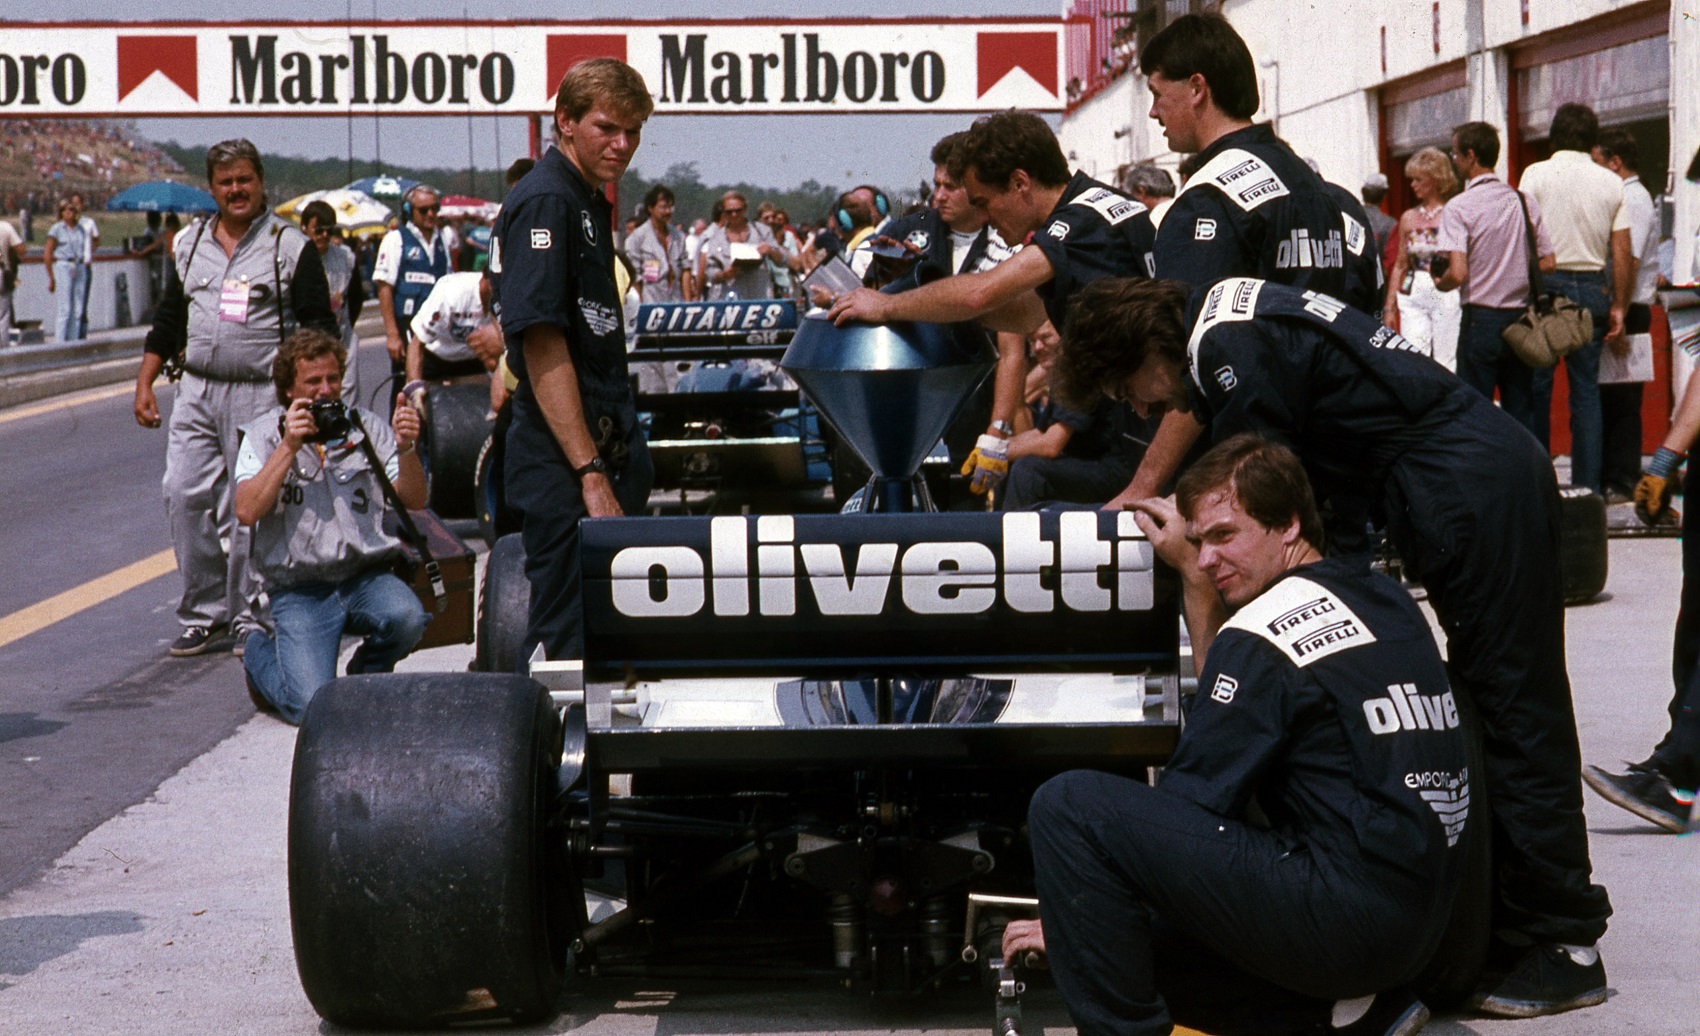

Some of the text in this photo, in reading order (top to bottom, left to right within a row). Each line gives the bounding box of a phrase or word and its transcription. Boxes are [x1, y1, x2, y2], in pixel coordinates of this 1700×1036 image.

[229, 35, 515, 104] Marlboro
[659, 33, 946, 103] Marlboro
[1216, 159, 1260, 186] PIRELLI
[1238, 178, 1280, 203] PIRELLI
[1107, 202, 1140, 219] PIRE
[645, 304, 783, 331] GITANES
[1232, 281, 1256, 315] PIRELLI
[611, 511, 1154, 617] olivetti
[1266, 596, 1336, 636] PIRELLI
[1291, 619, 1360, 658] PIRELLI
[1362, 683, 1460, 735] olive
